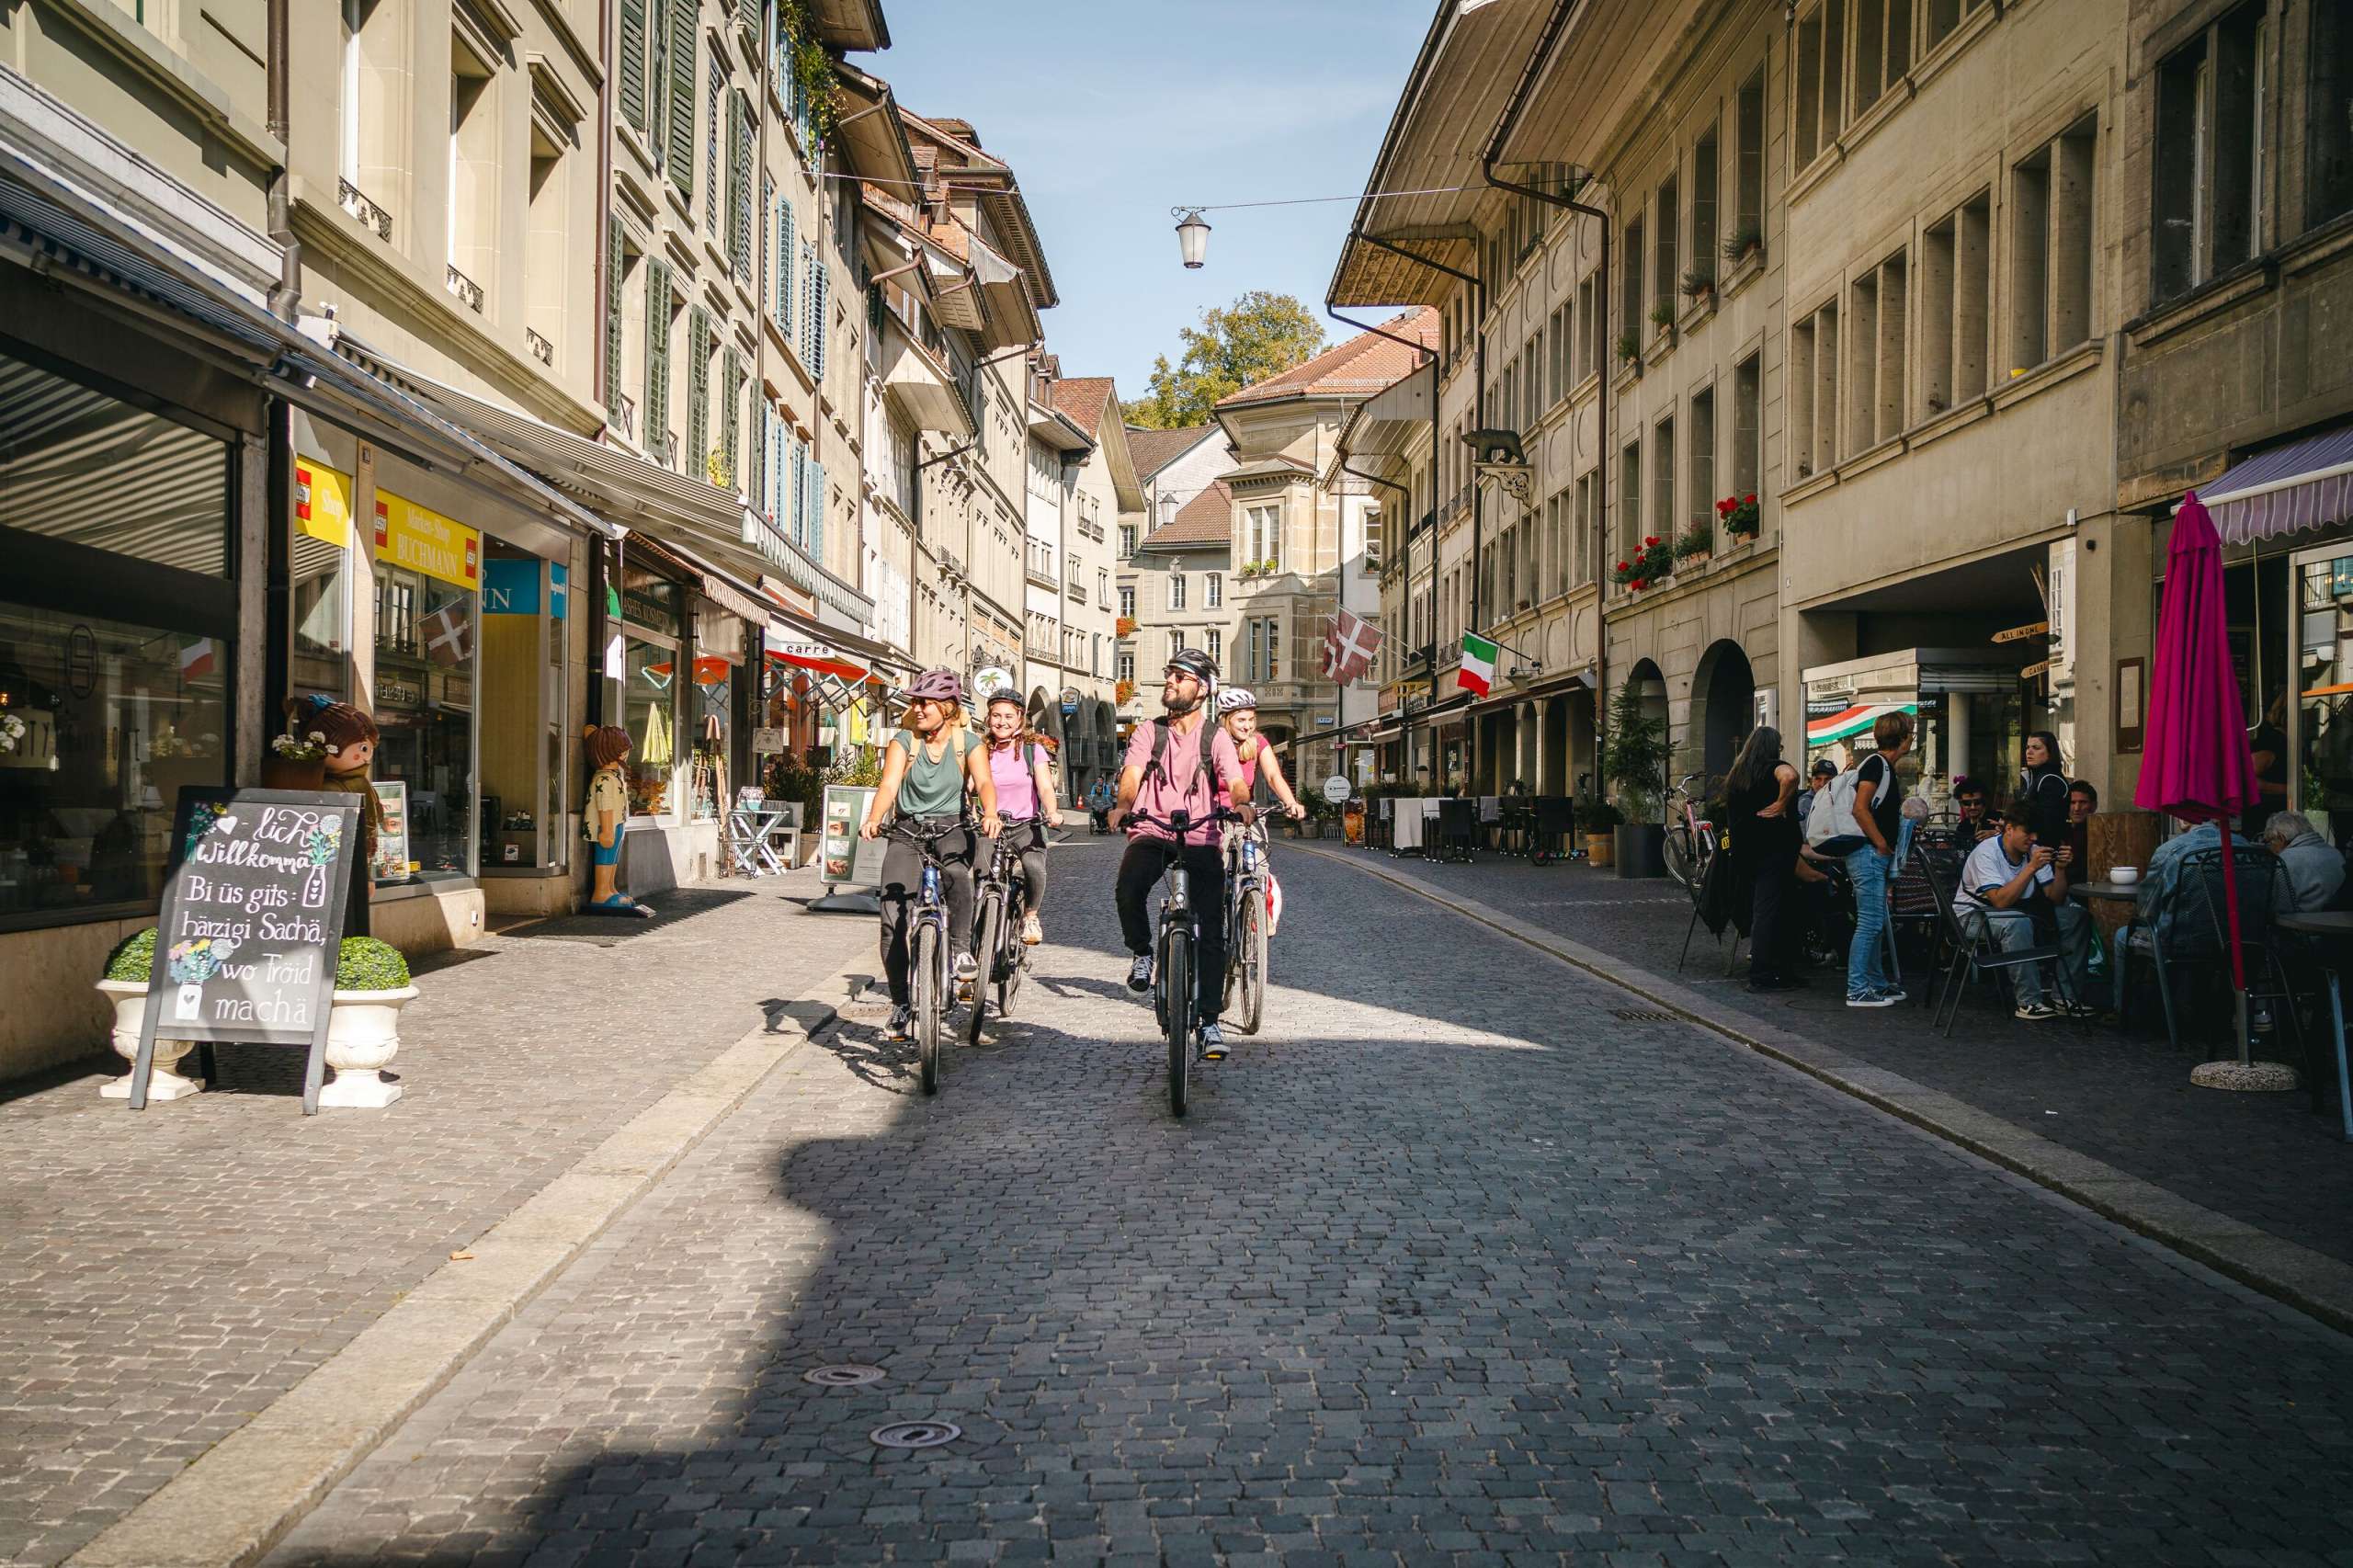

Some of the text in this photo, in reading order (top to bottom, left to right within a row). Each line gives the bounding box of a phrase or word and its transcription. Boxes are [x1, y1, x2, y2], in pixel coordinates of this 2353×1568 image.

[397, 532, 458, 578] BUCHMANN
[2001, 631, 2015, 640] ALL
[185, 875, 213, 903] Bi
[218, 882, 244, 903] üs
[180, 911, 251, 949] härzigi
[222, 963, 258, 982] wo
[214, 988, 308, 1025] machä
